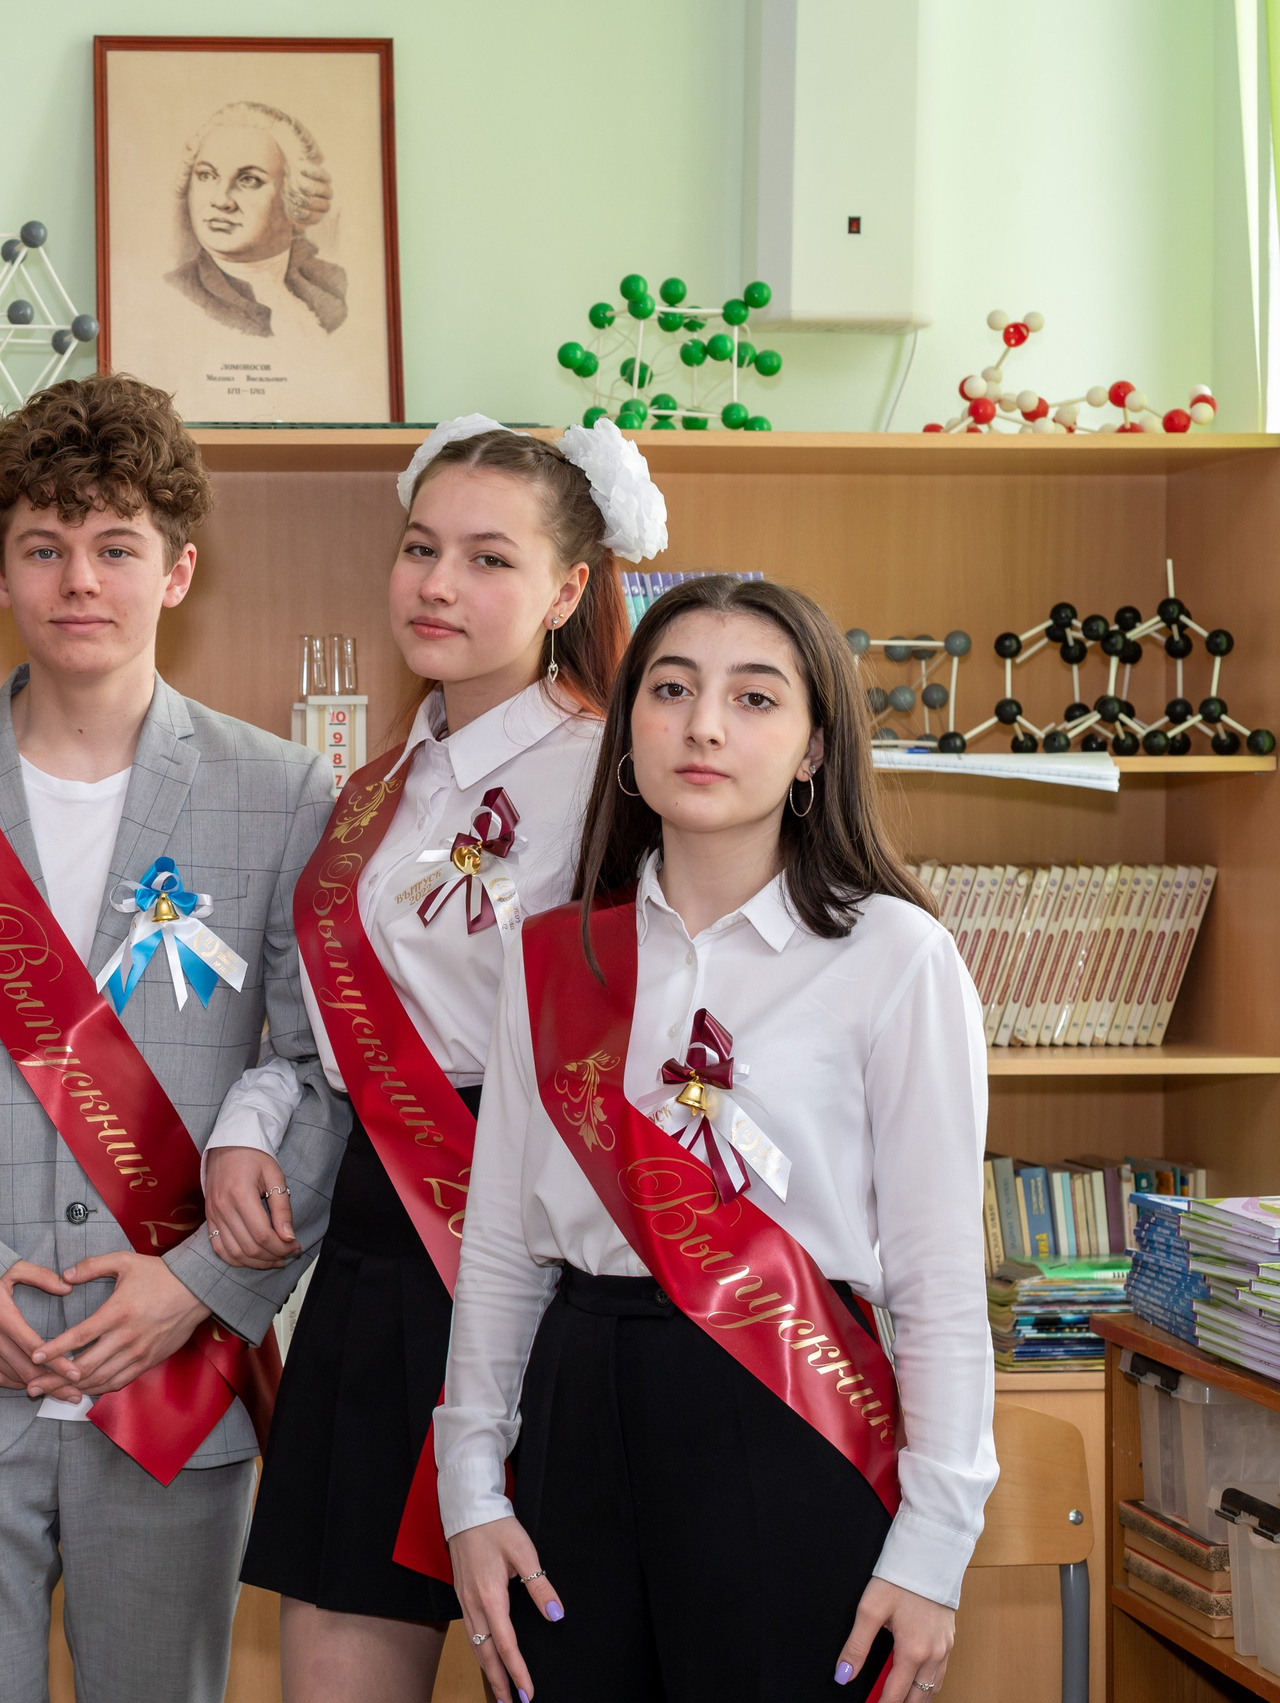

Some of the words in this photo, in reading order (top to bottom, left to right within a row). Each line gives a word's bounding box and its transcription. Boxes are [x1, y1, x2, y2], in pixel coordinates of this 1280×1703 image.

[329, 711, 347, 723] 10
[332, 732, 343, 744] 9
[332, 753, 343, 765] 8
[335, 775, 343, 786] 7
[394, 868, 443, 905] ВЫПУСК
[408, 883, 432, 906] 2022
[312, 852, 444, 1149] Выпускник
[618, 1157, 895, 1444] Выпускник
